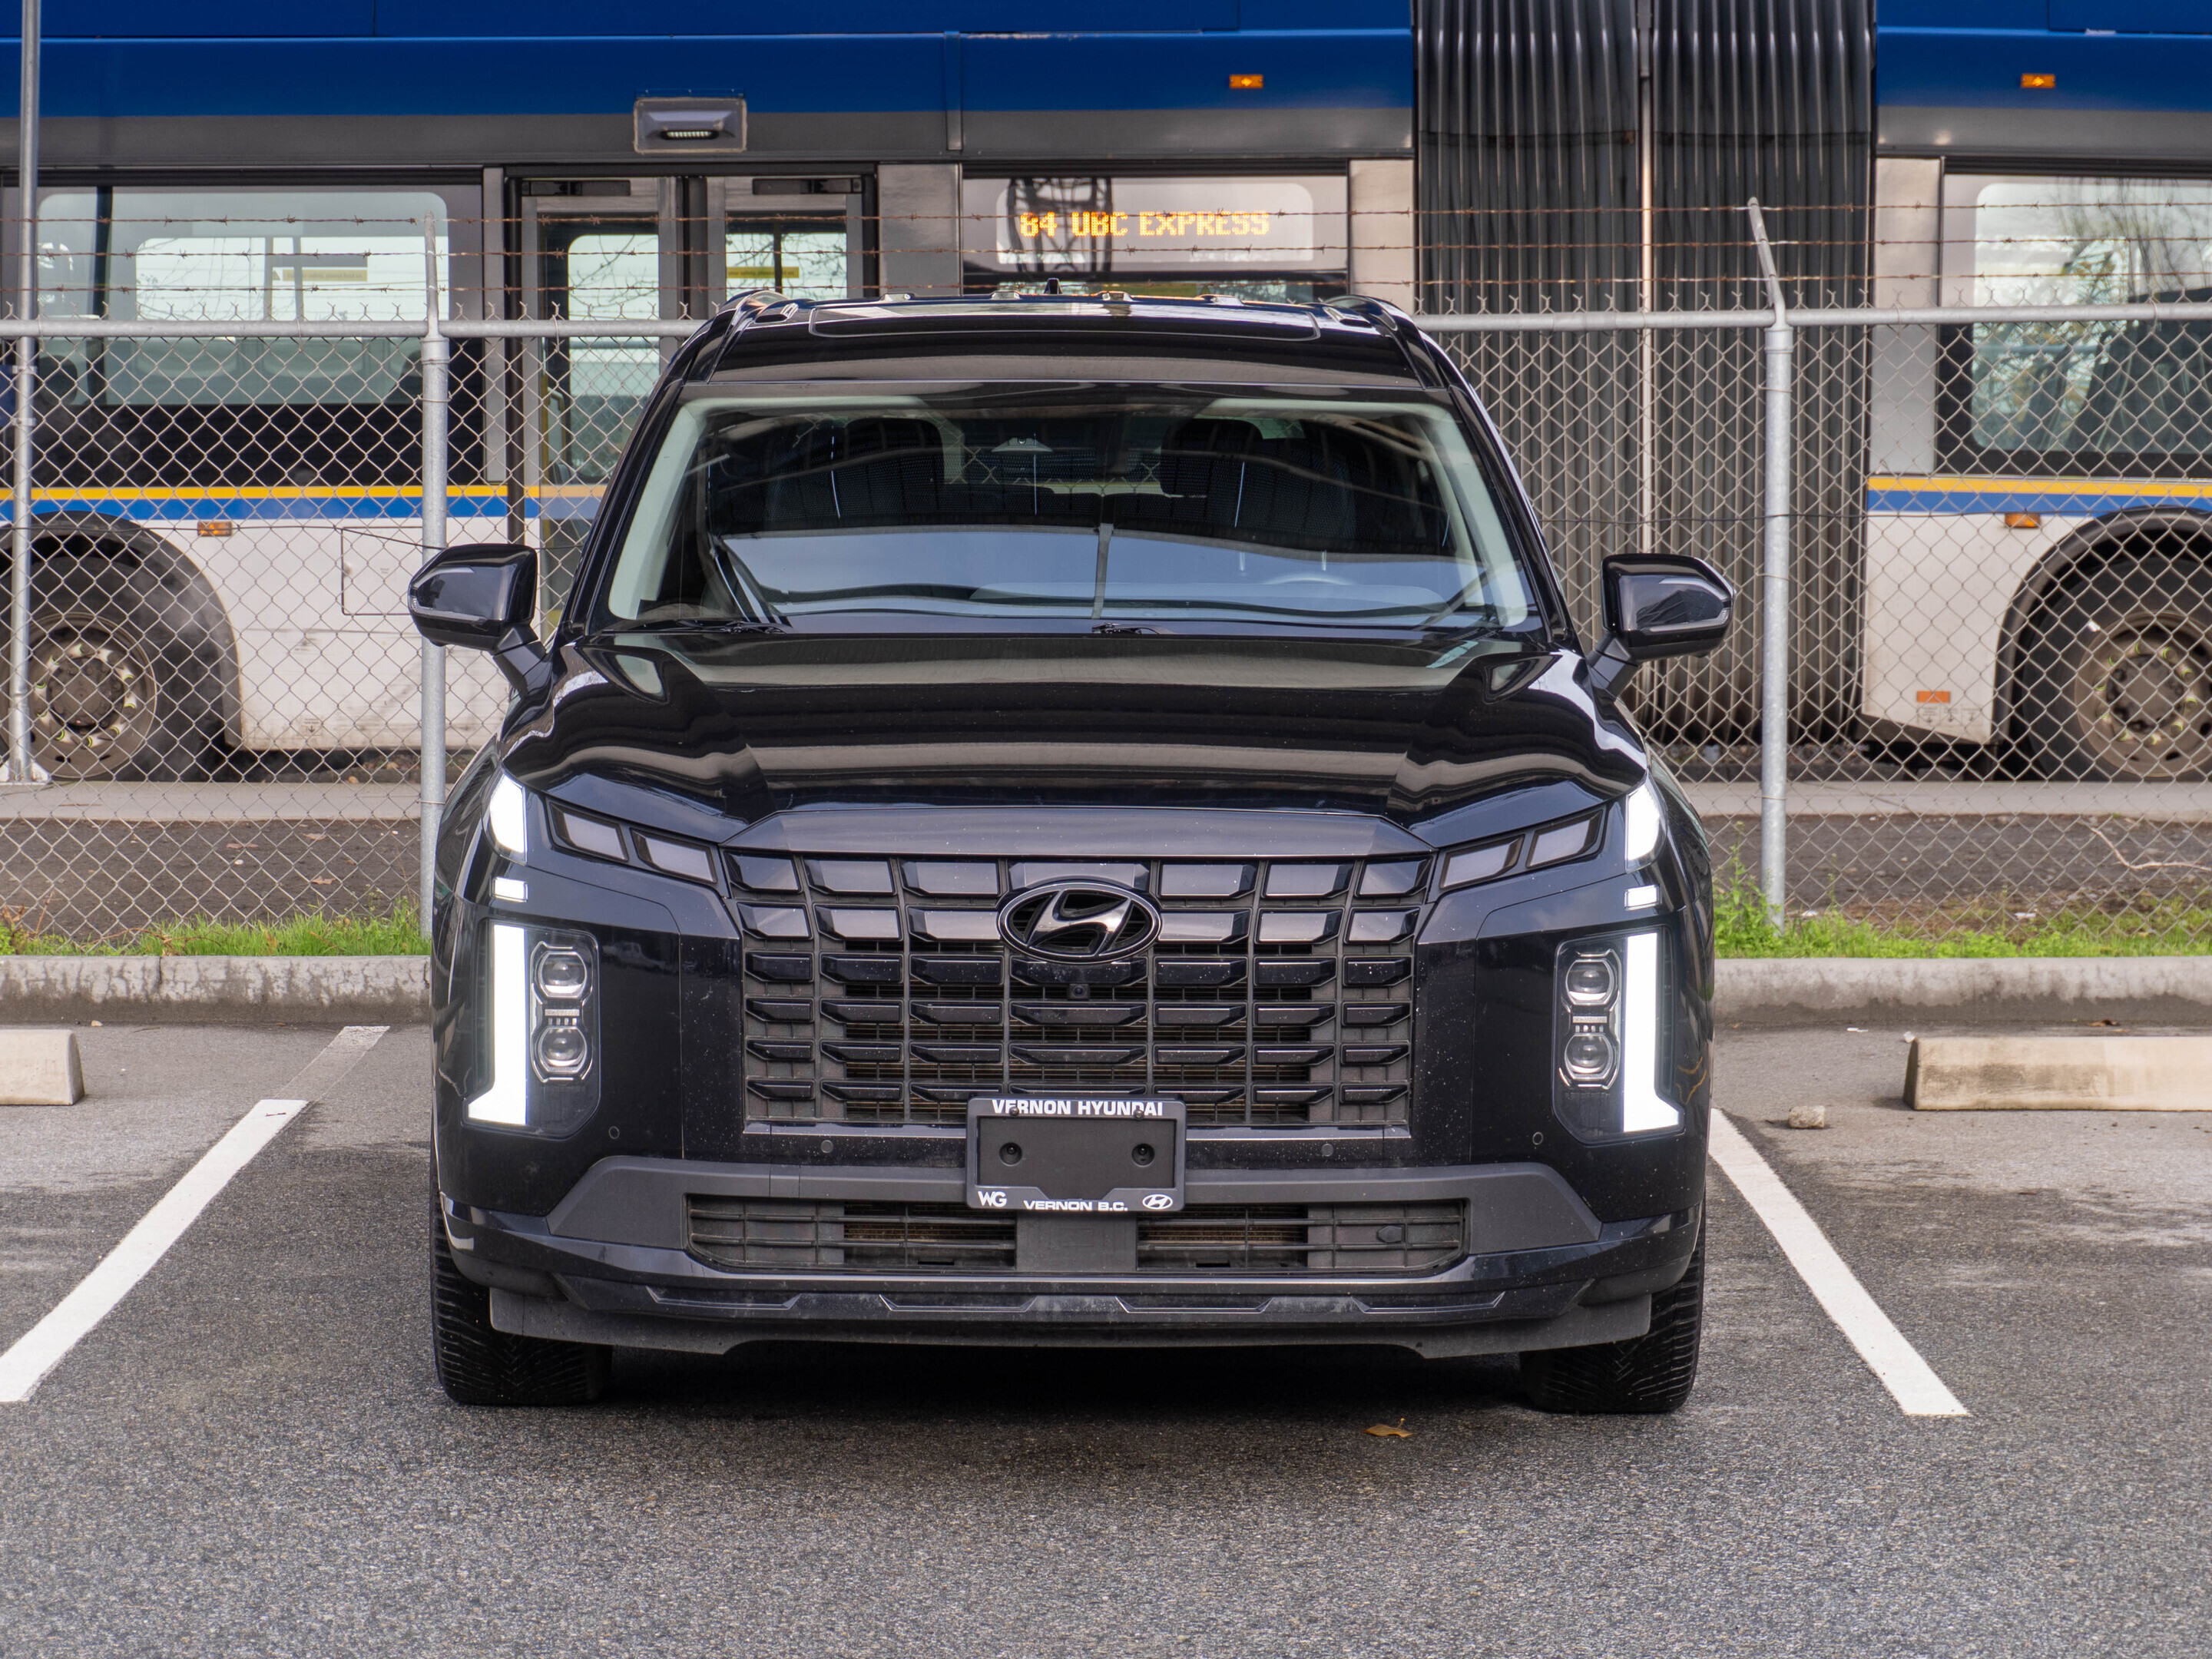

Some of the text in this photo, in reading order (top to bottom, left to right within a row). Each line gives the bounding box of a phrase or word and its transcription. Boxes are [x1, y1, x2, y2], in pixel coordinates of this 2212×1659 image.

[1071, 211, 1128, 237] UBC
[1138, 210, 1269, 237] EXPRESS
[991, 1098, 1071, 1115] VERNON
[978, 1191, 1008, 1207] WG
[1023, 1200, 1128, 1211] VERNON B.C.
